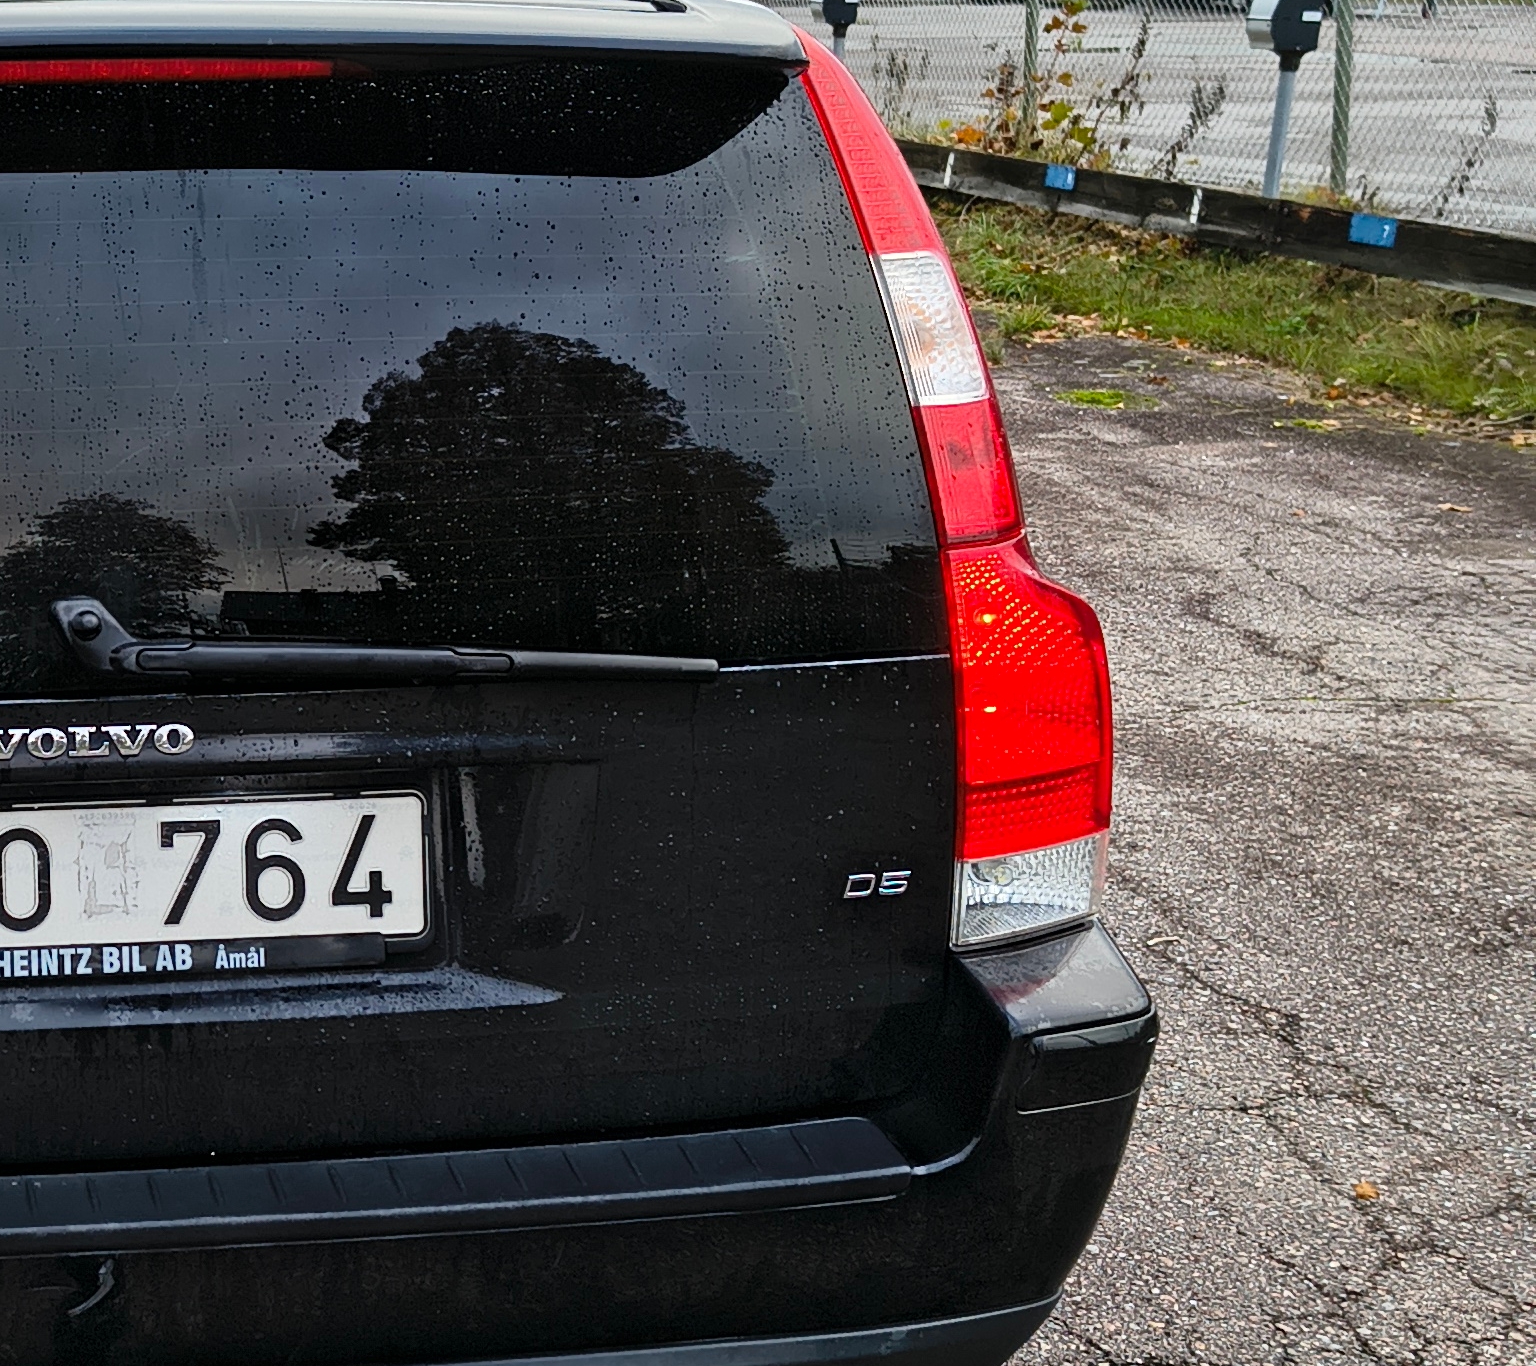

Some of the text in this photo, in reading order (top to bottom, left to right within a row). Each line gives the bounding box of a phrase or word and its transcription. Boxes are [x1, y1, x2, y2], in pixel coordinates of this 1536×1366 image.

[159, 814, 393, 925] 764
[843, 870, 912, 899] D5
[102, 945, 147, 975] BIL
[155, 943, 194, 972] AB
[214, 943, 266, 970] Åmål
